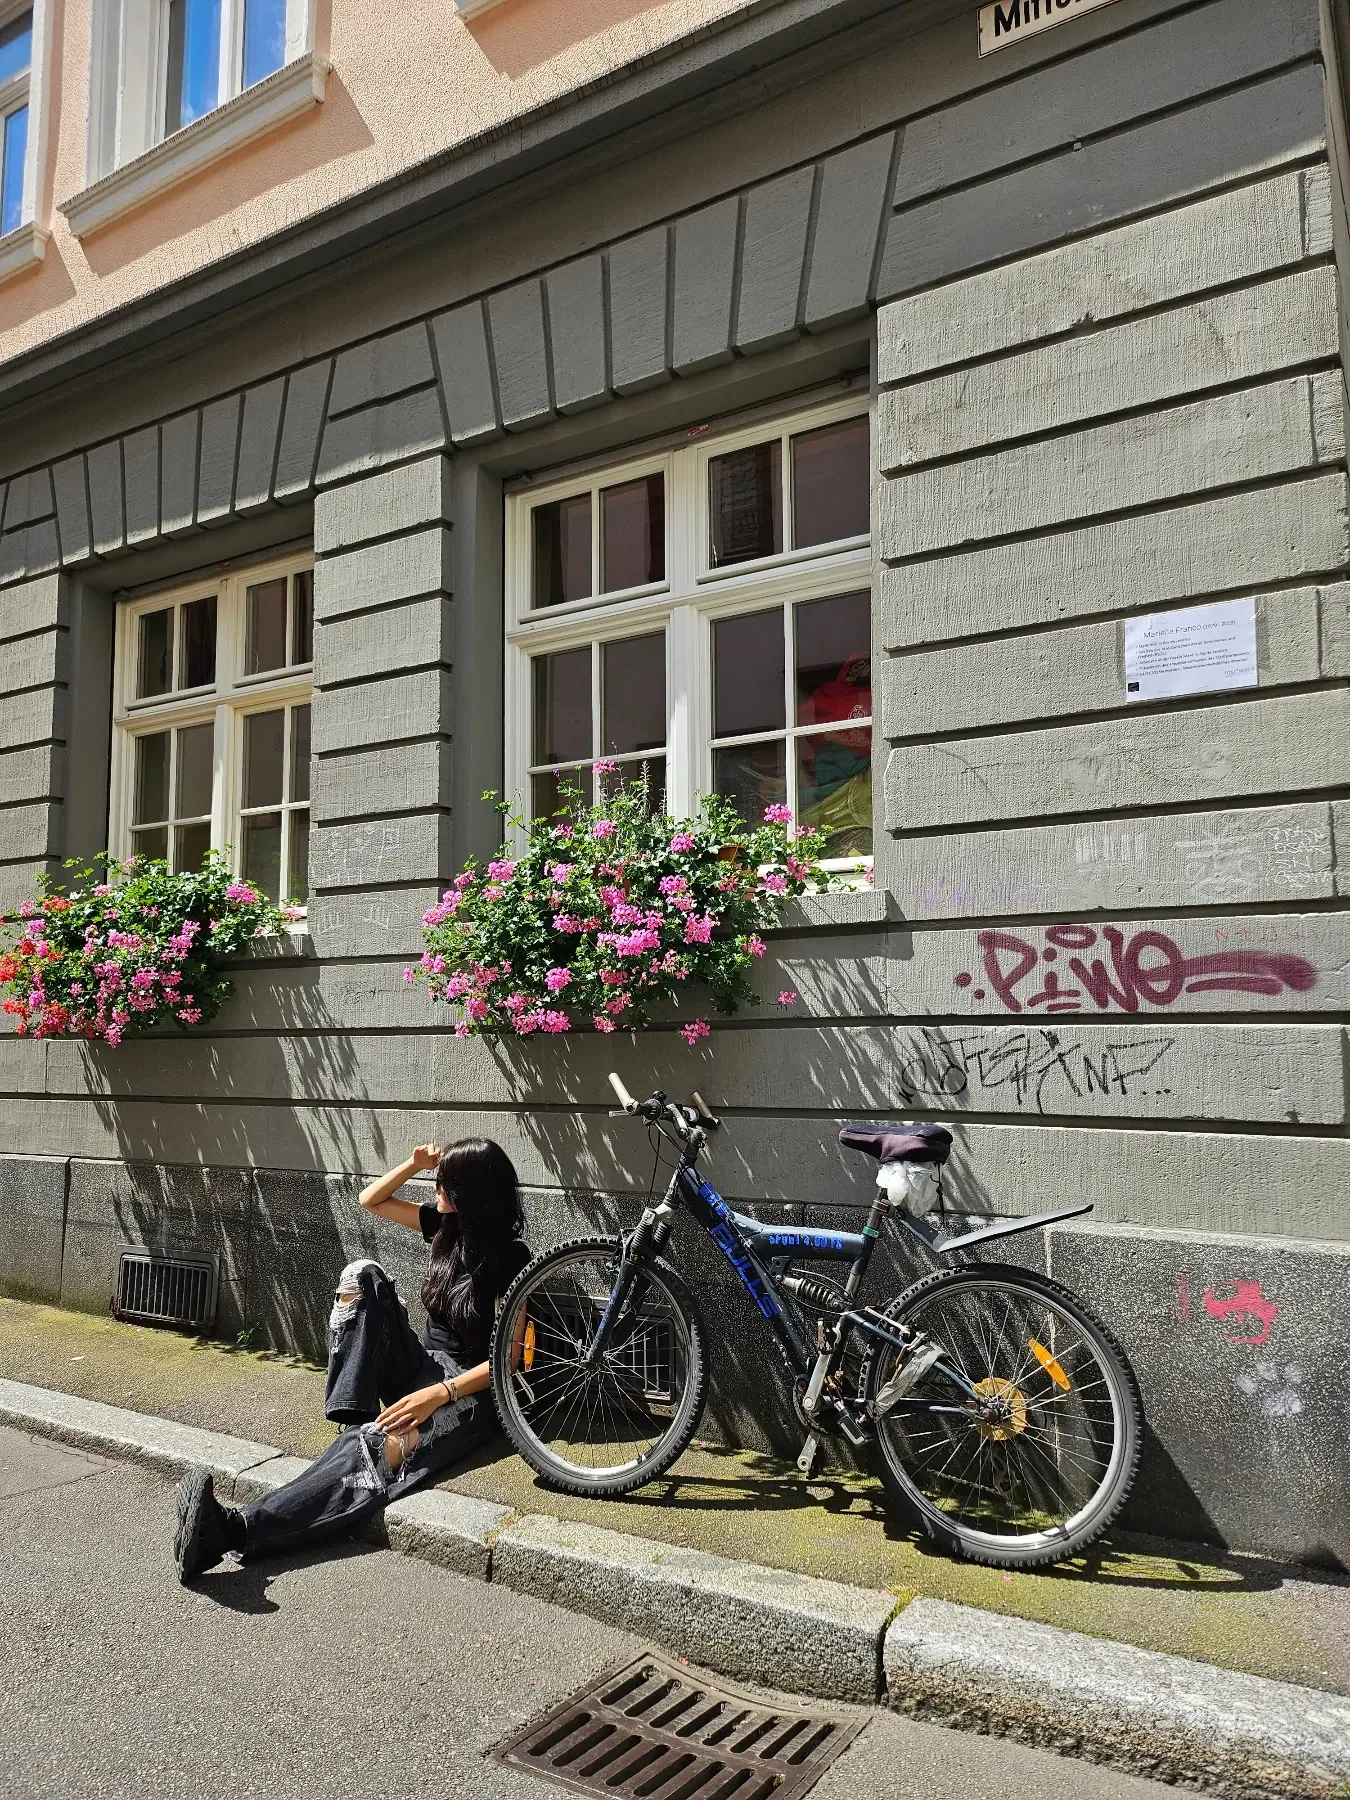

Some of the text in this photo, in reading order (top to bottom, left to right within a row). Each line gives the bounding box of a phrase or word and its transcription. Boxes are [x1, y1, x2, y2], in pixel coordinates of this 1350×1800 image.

[1143, 627, 1174, 639] Marielle
[1175, 624, 1200, 634] Franco
[711, 1222, 778, 1319] BULLS
